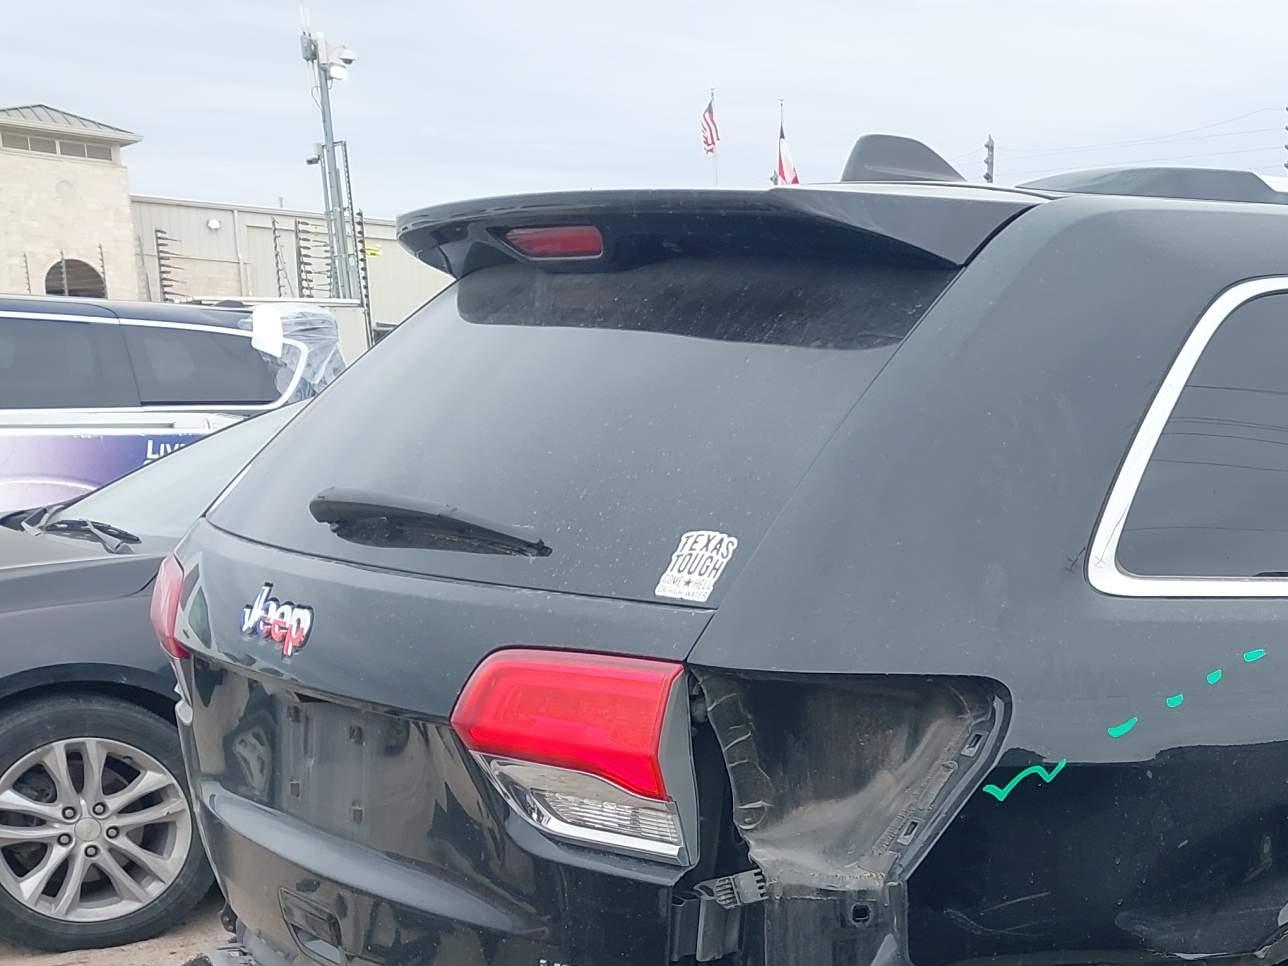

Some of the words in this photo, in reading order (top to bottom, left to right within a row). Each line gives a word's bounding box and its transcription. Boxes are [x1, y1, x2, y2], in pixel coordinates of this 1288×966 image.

[680, 534, 735, 559] TEXAS
[670, 552, 724, 579] TOUGH
[241, 582, 314, 656] Jeep
